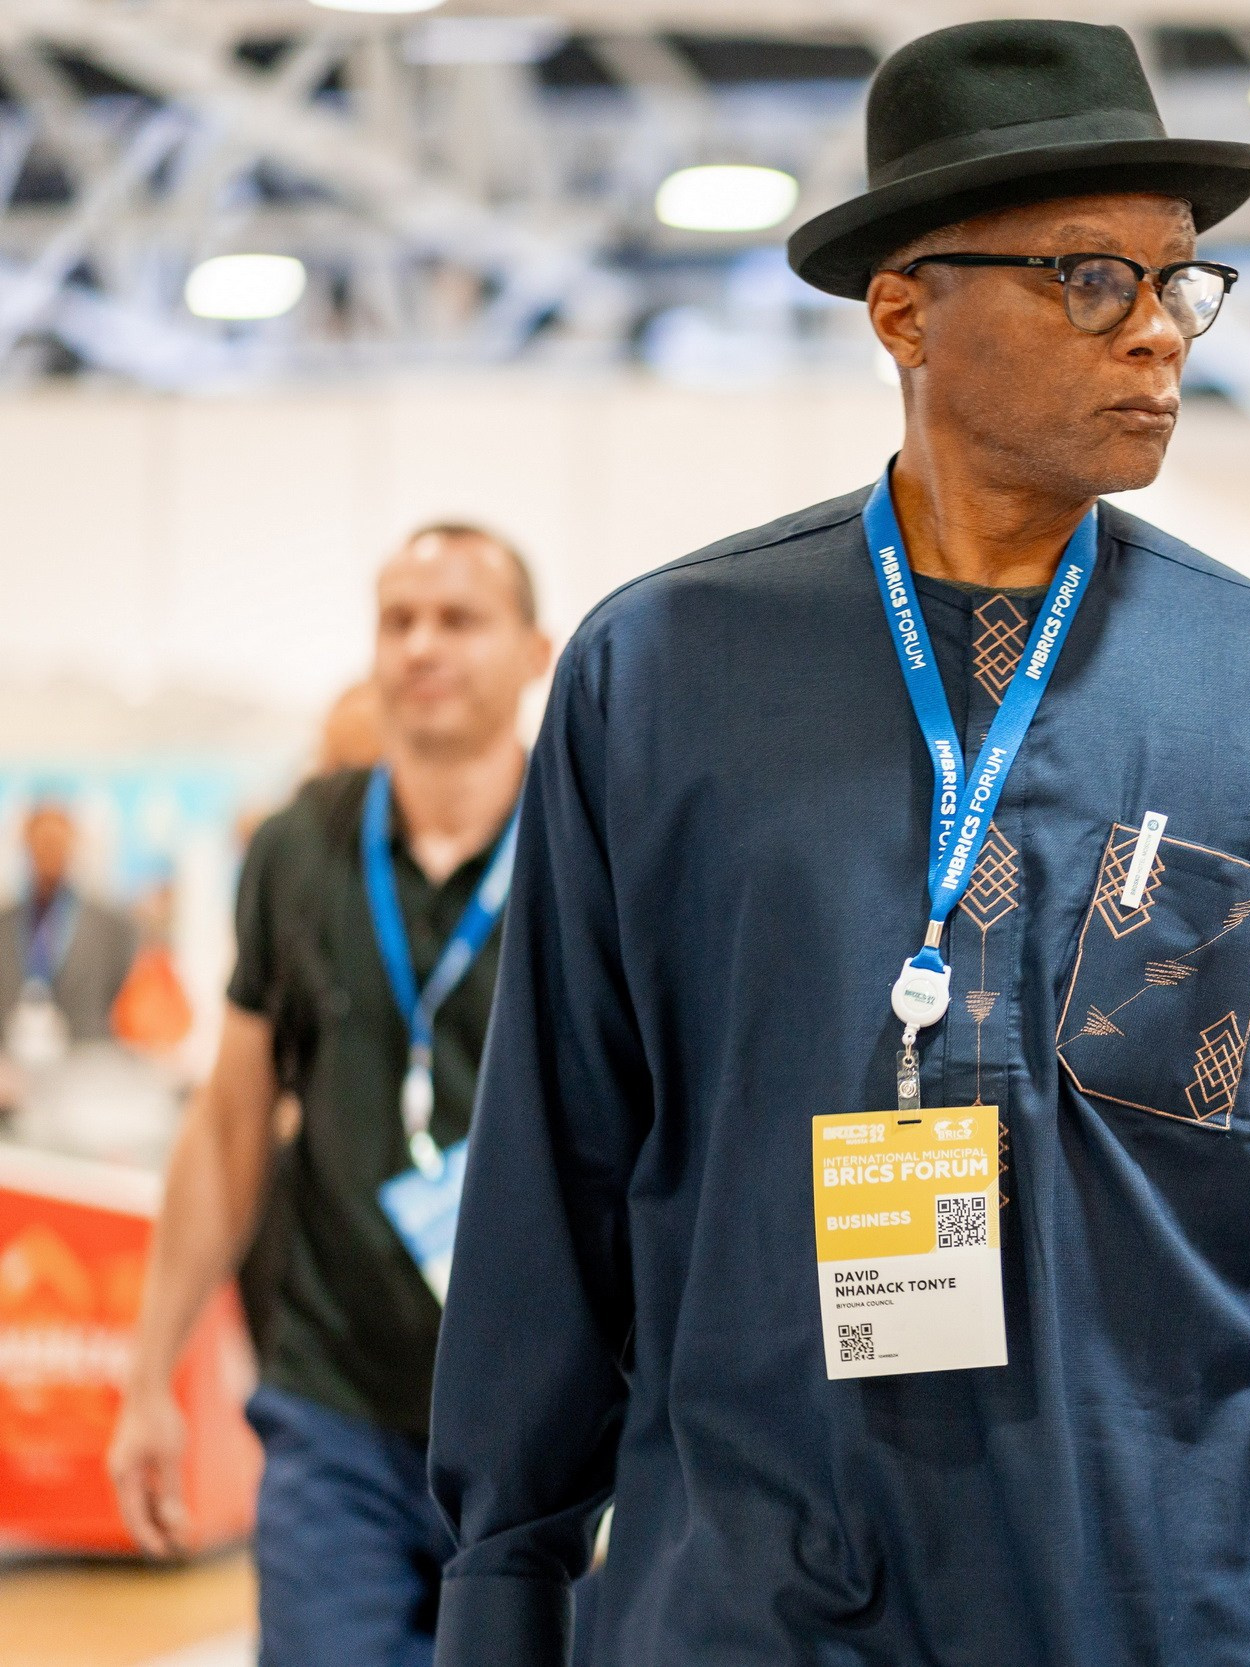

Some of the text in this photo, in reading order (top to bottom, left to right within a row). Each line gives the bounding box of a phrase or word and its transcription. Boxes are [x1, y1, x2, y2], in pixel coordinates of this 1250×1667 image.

[878, 545, 926, 670] IMBRICS FORUM
[1025, 564, 1084, 681] IMBRICS FORUM
[935, 740, 957, 816] IMBRICS
[941, 815, 981, 891] IMBRICS
[969, 746, 1008, 814] FORUM
[823, 1147, 988, 1167] INTERNATIONAL MUNICIPAL
[823, 1158, 988, 1187] BRICS FORUM
[826, 1210, 911, 1231] BUSINESS
[834, 1269, 879, 1284] DAVID
[835, 1277, 957, 1298] NHANACK TONYE
[866, 1299, 895, 1307] COUNCIL
